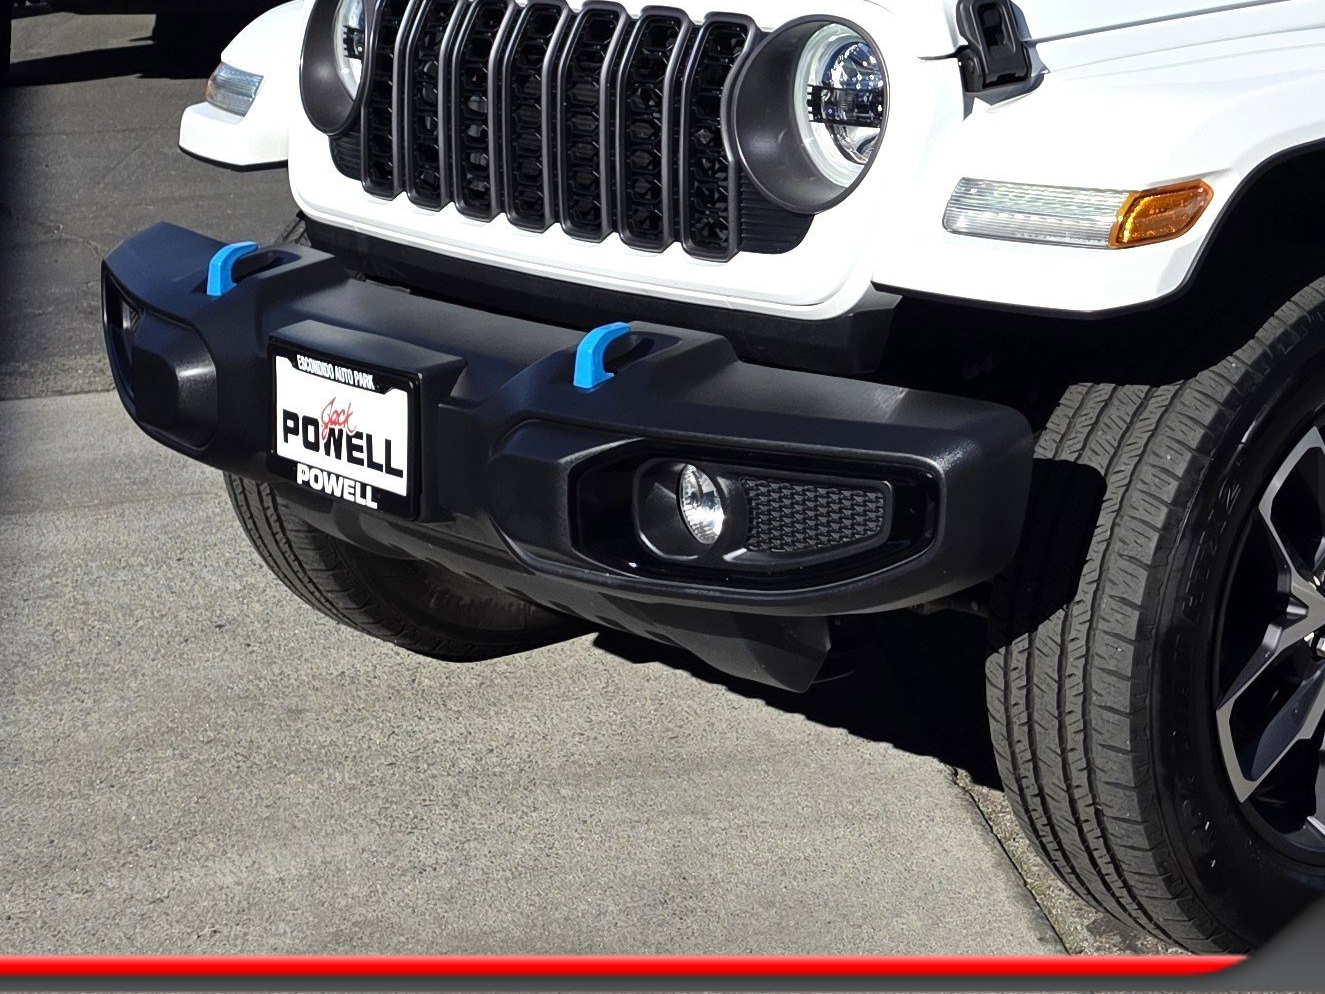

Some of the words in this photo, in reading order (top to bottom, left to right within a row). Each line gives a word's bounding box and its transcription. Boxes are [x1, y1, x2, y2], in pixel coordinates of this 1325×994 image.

[297, 354, 335, 379] ESCONDIDO
[335, 366, 353, 385] AUTO
[354, 370, 375, 390] PARK
[321, 396, 357, 440] Jack
[282, 408, 404, 479] POWELL
[296, 462, 378, 509] POWELL
